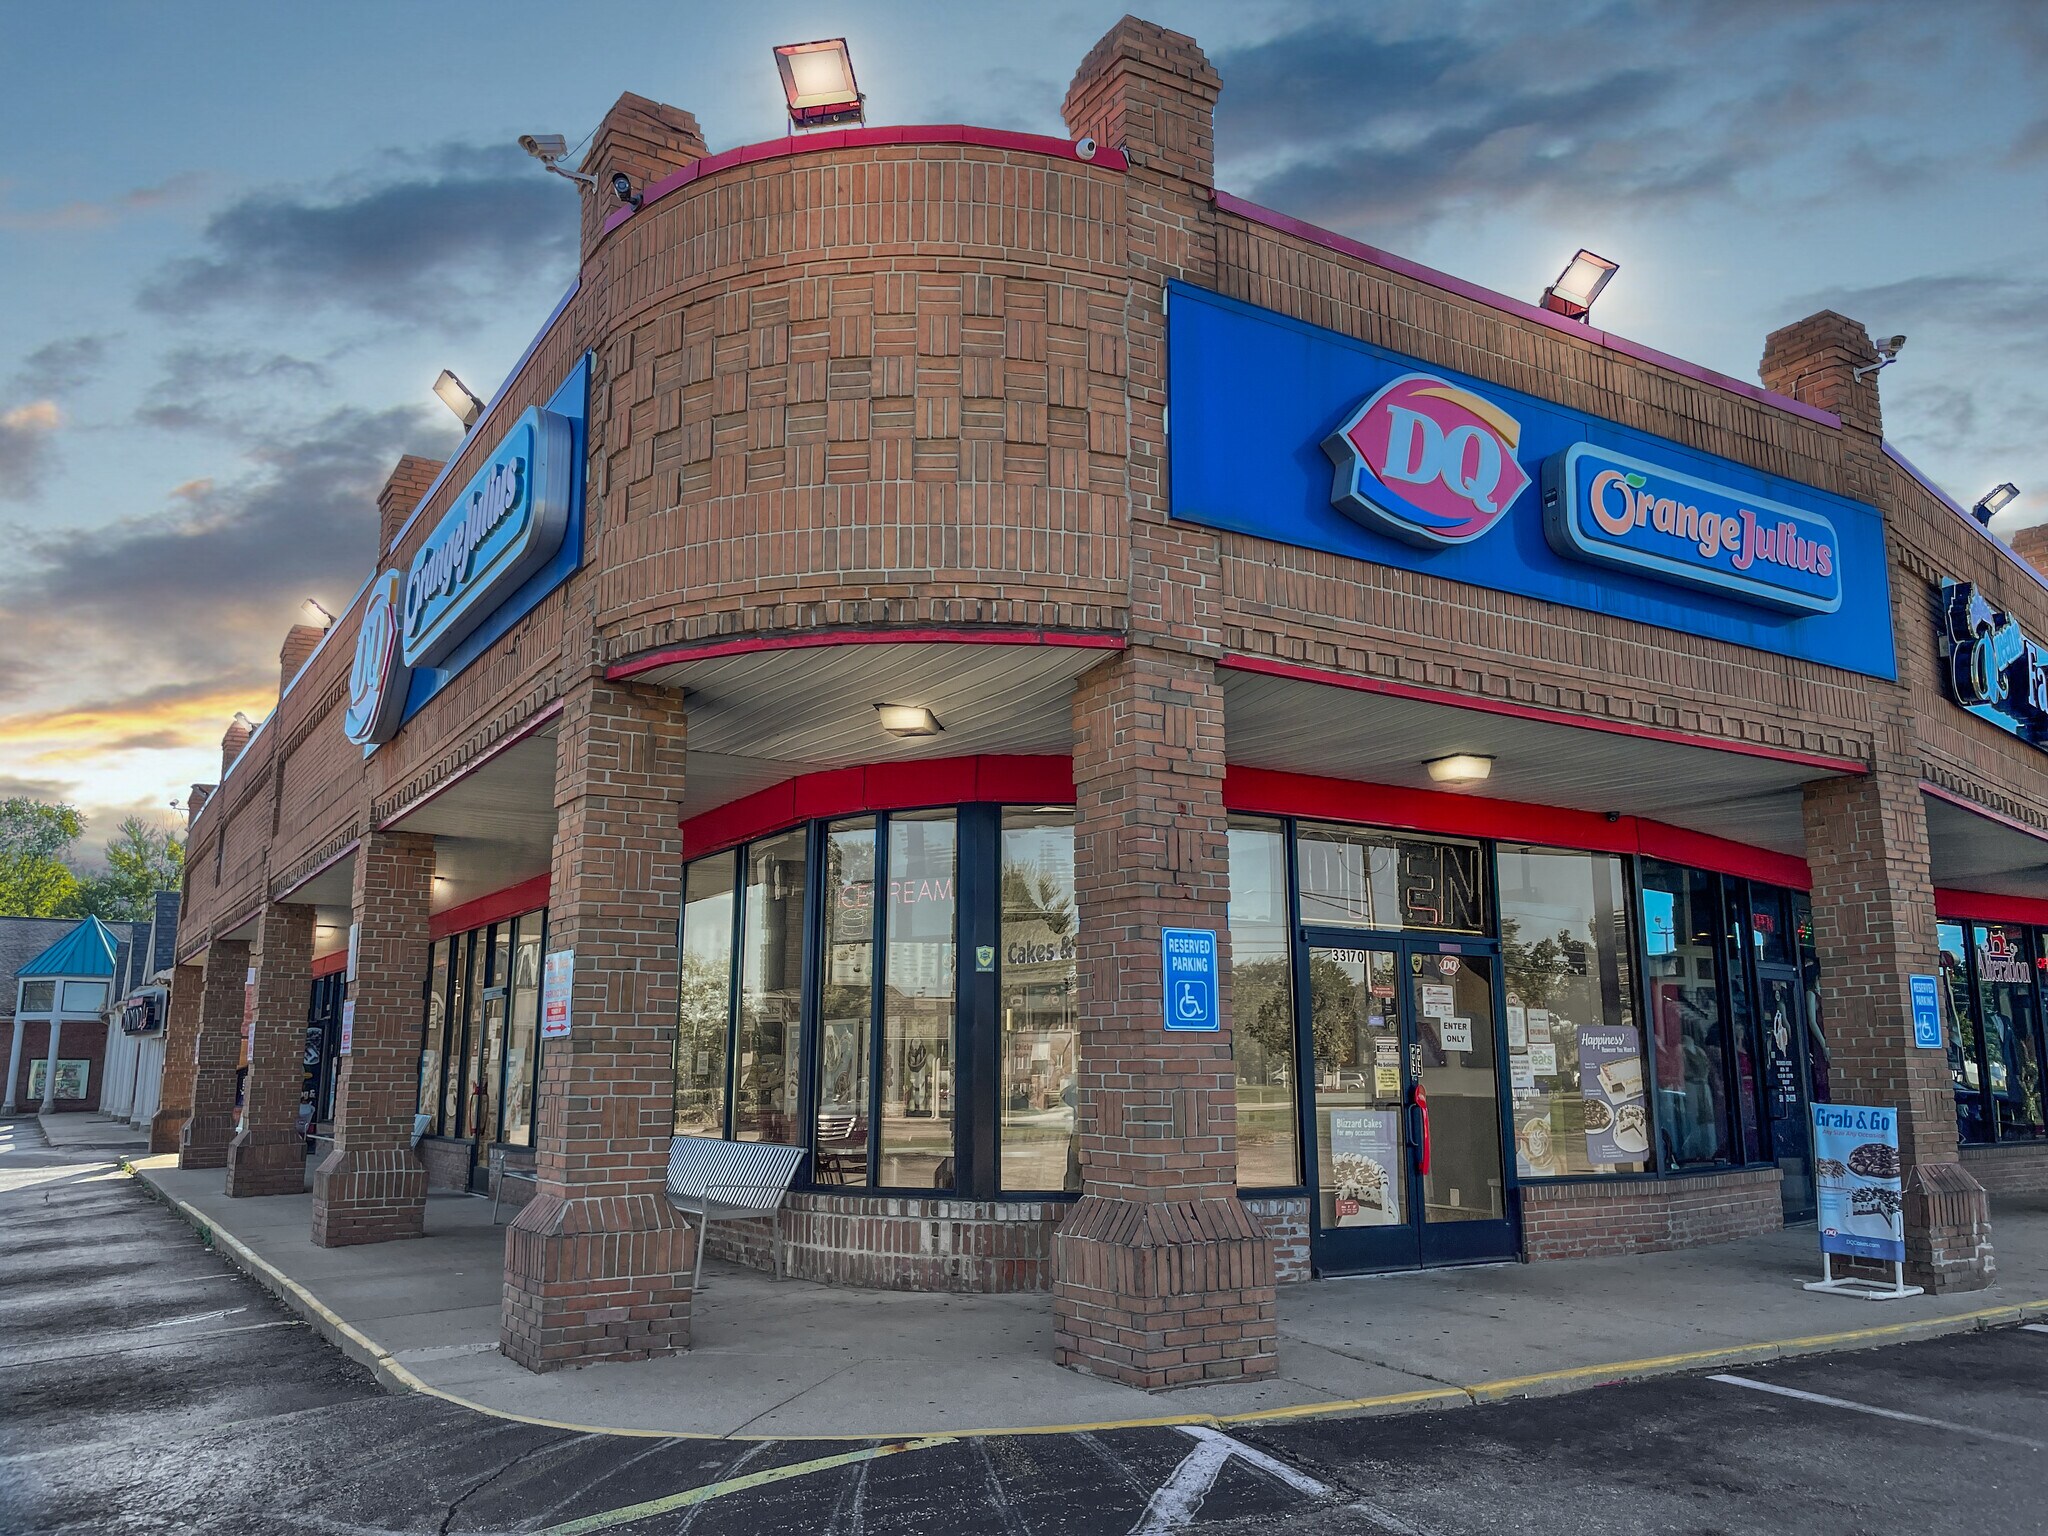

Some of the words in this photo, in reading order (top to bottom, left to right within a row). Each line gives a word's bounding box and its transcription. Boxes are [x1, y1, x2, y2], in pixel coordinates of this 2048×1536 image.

[1381, 404, 1503, 514] DQ
[837, 884, 869, 908] ICE
[890, 878, 953, 904] REAM
[1168, 938, 1210, 954] RESERVED
[1007, 940, 1055, 965] Cakes
[1332, 949, 1364, 963] 33170
[1172, 956, 1208, 972] PARKING
[1443, 960, 1457, 970] DQ
[1913, 982, 1934, 994] RESERVED
[1916, 995, 1934, 1007] PARKING
[1443, 1022, 1467, 1030] ENTER
[1446, 1034, 1465, 1042] ONLY
[1581, 1032, 1625, 1050] Happiness
[1531, 1055, 1553, 1065] eats
[1512, 1087, 1540, 1099] umpkin
[1336, 1118, 1362, 1129] Blizzard
[1363, 1118, 1382, 1129] Cakes
[1816, 1107, 1853, 1129] Grab
[1855, 1110, 1868, 1130] &
[1870, 1111, 1890, 1131] Go
[1825, 1229, 1838, 1238] DQ
